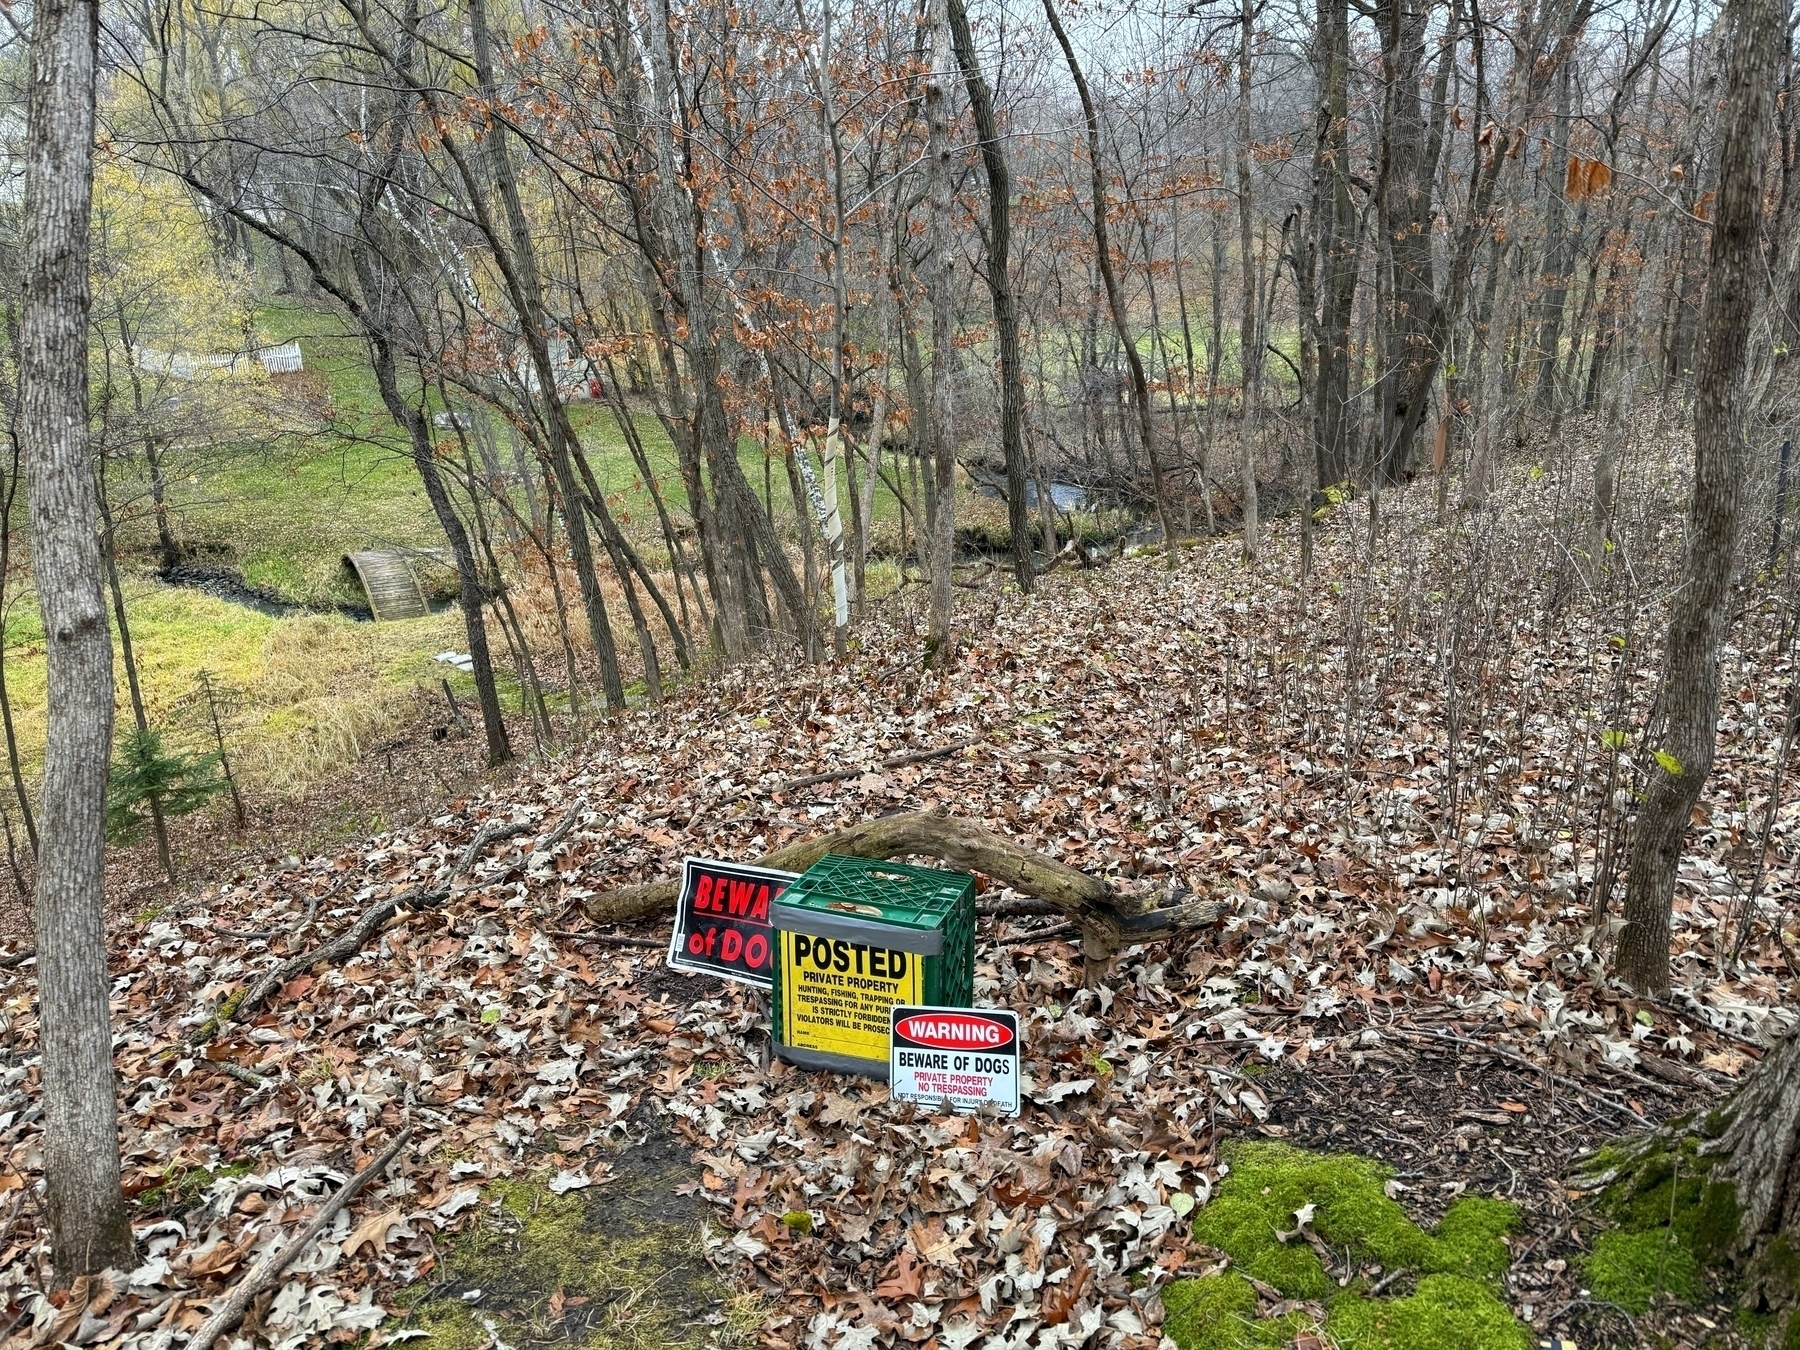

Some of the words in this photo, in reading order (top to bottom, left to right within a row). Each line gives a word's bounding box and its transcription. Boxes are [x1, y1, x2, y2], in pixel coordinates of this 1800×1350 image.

[694, 874, 785, 920] BEWA
[688, 927, 717, 957] of
[721, 929, 773, 968] DO
[795, 934, 907, 980] POSTED
[803, 971, 844, 986] PRIVATE
[847, 976, 899, 994] PROPERTY
[797, 994, 843, 1007] TRESPASSING
[844, 1000, 858, 1010] FOR
[860, 1002, 874, 1012] ANY
[875, 1005, 891, 1015] PUR
[798, 984, 829, 996] HUNTING,
[831, 988, 858, 1001] FISHING,
[860, 993, 893, 1005] TRAPPING
[812, 1005, 819, 1014] IS
[820, 1007, 852, 1018] STRICTLY
[797, 1014, 834, 1026] VIOLATORS
[835, 1018, 850, 1029] WILL
[852, 1021, 861, 1031] BE
[908, 1020, 1000, 1043] WARNING
[899, 1052, 948, 1070] BEWARE
[953, 1055, 970, 1071] OF
[975, 1057, 1010, 1075] DOGS
[914, 1071, 947, 1083] PRIVATE
[950, 1074, 993, 1087] PROPERTY
[918, 1082, 930, 1092] NO
[933, 1083, 987, 1097] TRESPASSING
[950, 1096, 962, 1104] FOR
